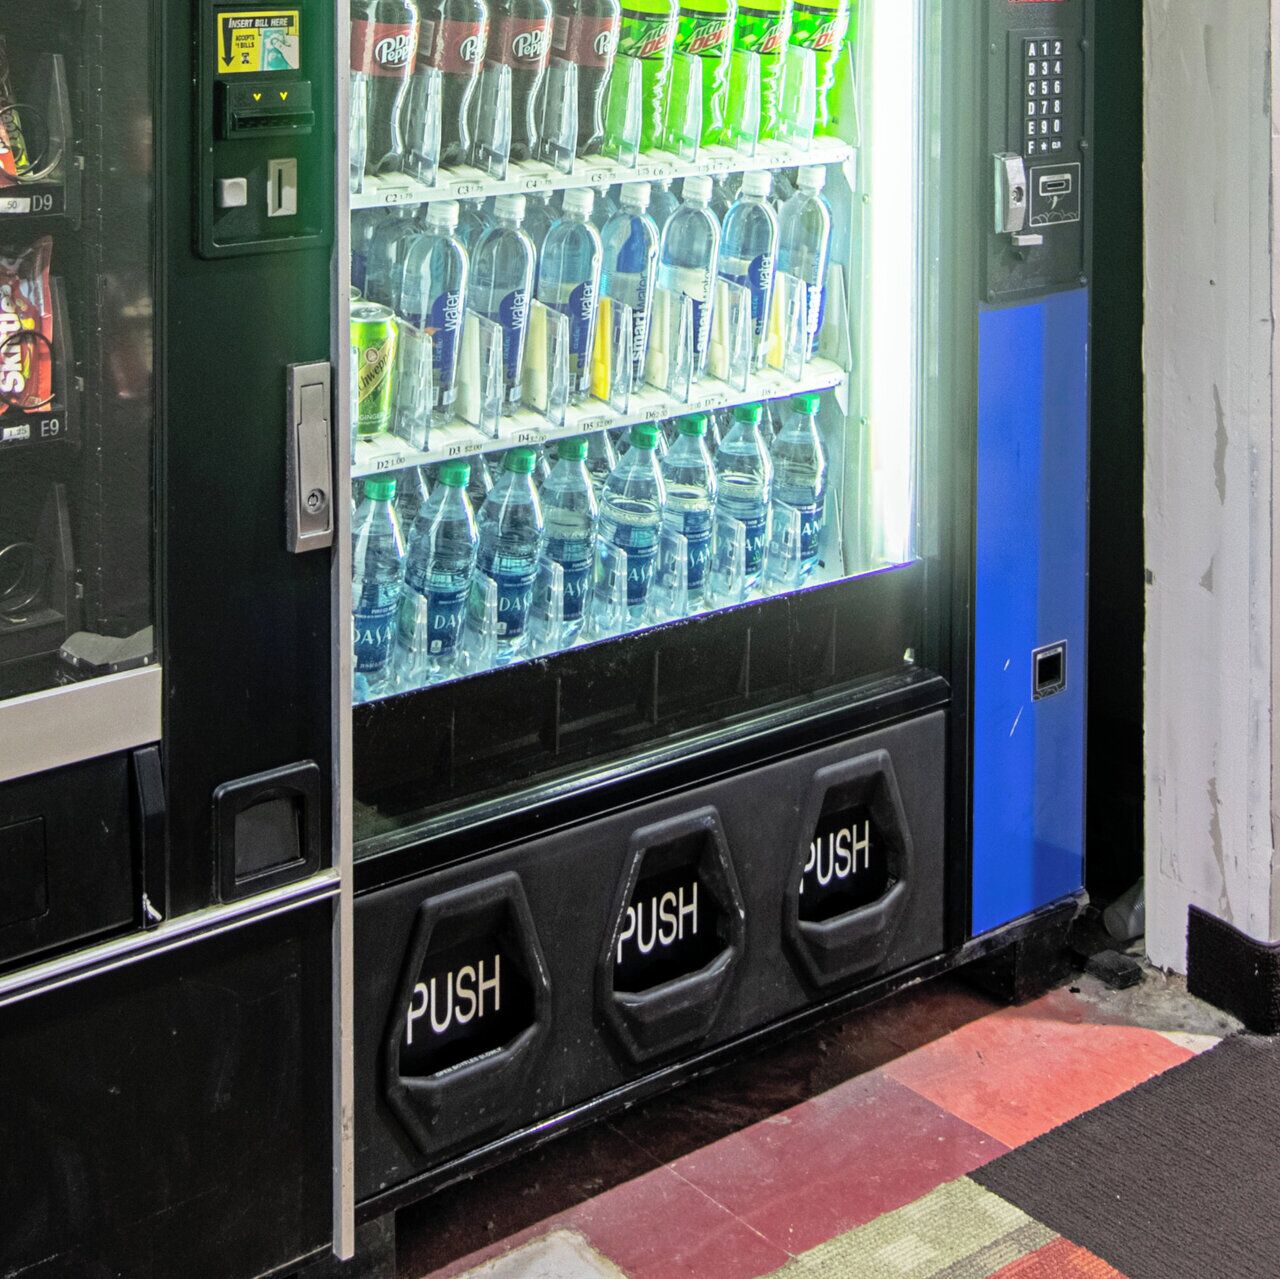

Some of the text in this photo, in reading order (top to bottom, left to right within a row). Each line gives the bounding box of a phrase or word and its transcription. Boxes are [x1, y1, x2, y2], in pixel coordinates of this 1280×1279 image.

[228, 17, 289, 28] INSERT BILL HERE
[457, 185, 470, 195] C3
[525, 179, 538, 190] C4
[31, 194, 53, 211] D9
[385, 193, 398, 203] C2
[41, 419, 60, 437] E9
[583, 421, 595, 432] D5
[518, 433, 530, 444] D4
[448, 446, 461, 457] D3
[376, 458, 390, 470] D2
[798, 820, 871, 895] PUSH
[616, 881, 699, 964] PUSH
[406, 953, 501, 1046] PUSH
